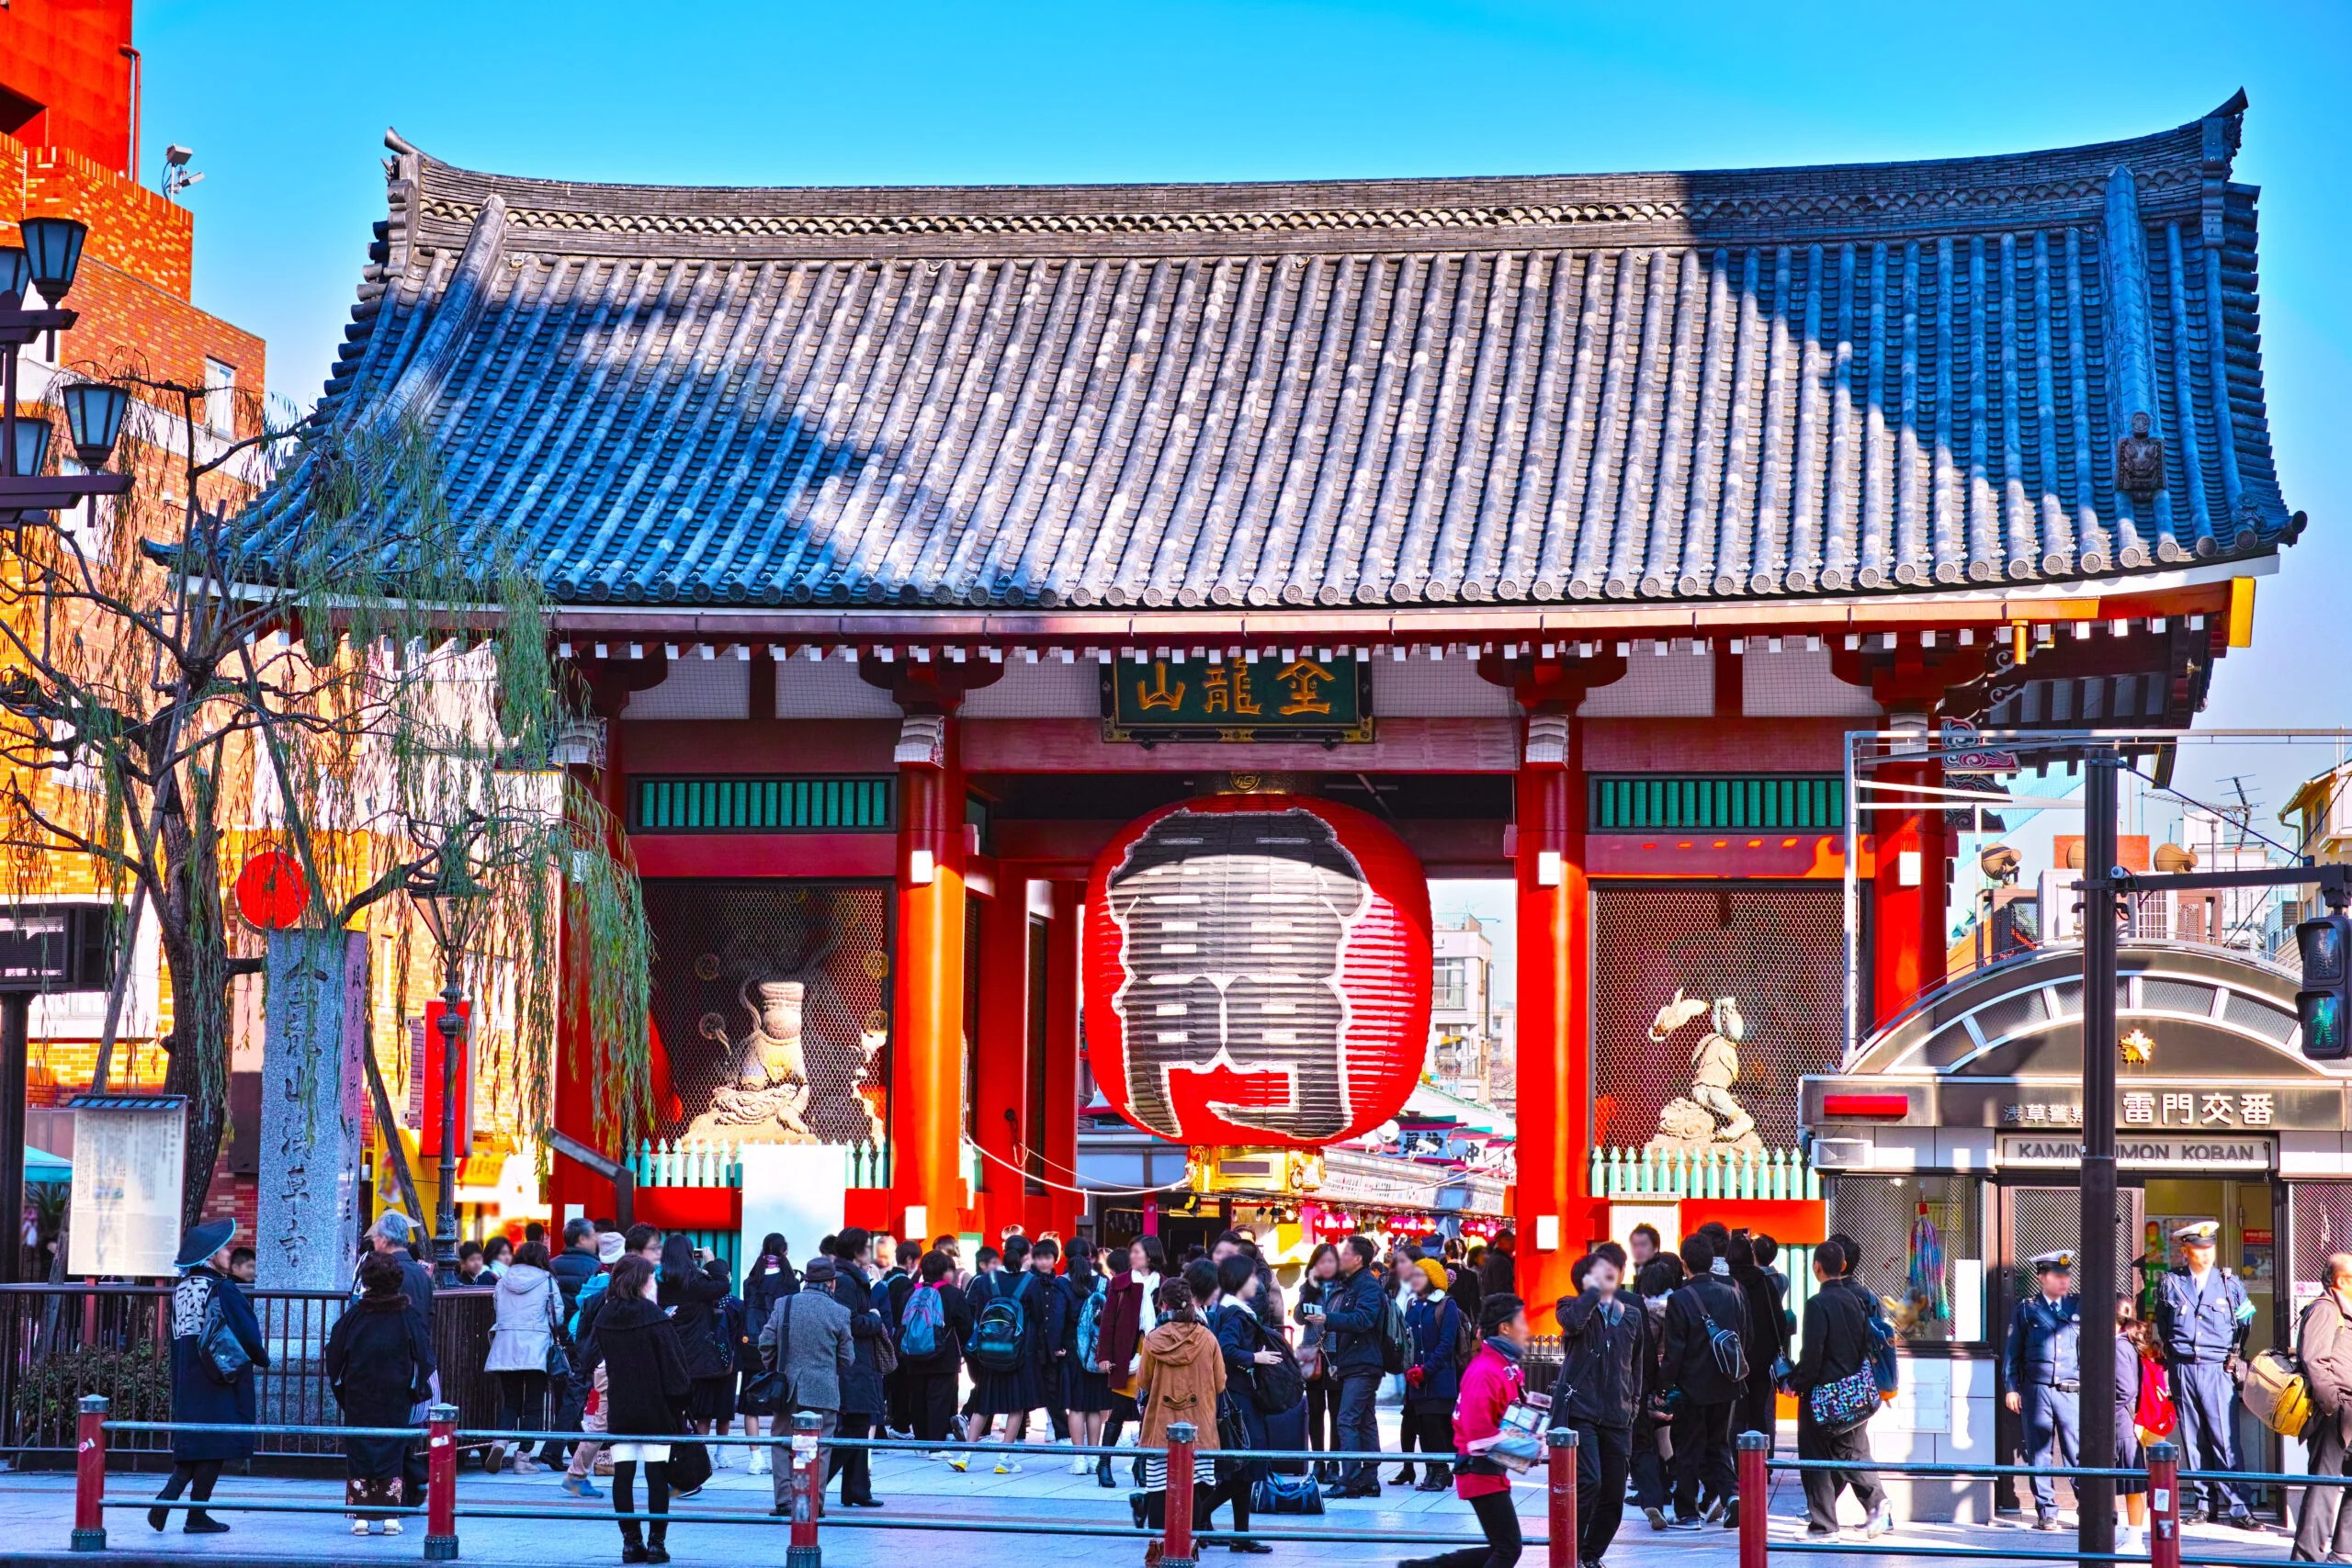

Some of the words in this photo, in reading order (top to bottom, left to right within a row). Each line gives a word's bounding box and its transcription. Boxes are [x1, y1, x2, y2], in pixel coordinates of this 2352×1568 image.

[1105, 807, 1373, 1140] 雷門
[2004, 1104, 2084, 1123] 浅草警察
[2122, 1092, 2274, 1125] 雷門交番
[2018, 1144, 2169, 1161] KAMINIMON
[2181, 1145, 2255, 1162] KOBAN
